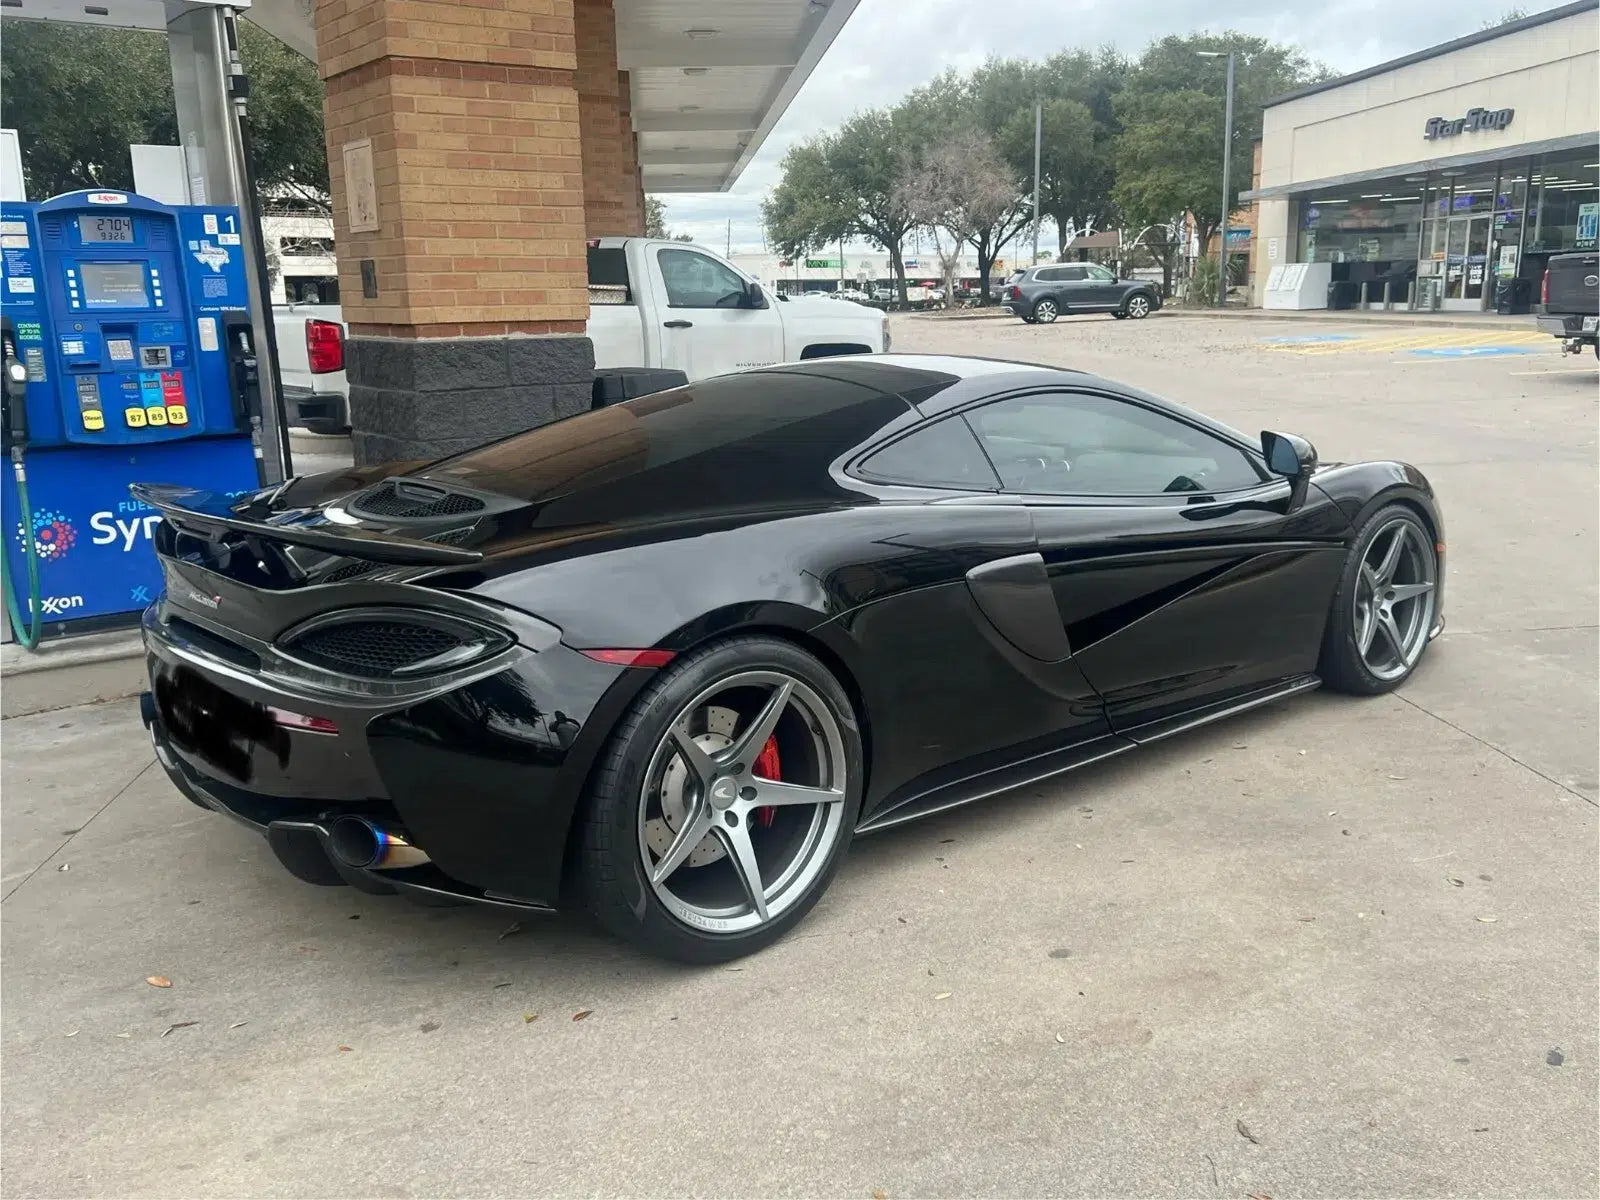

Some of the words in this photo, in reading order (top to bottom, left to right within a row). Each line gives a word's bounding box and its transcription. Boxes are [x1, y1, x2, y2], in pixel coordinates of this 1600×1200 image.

[1424, 117, 1466, 140] Star
[1464, 108, 1514, 132] Stop
[98, 194, 118, 202] Exxon
[225, 215, 235, 234] 1
